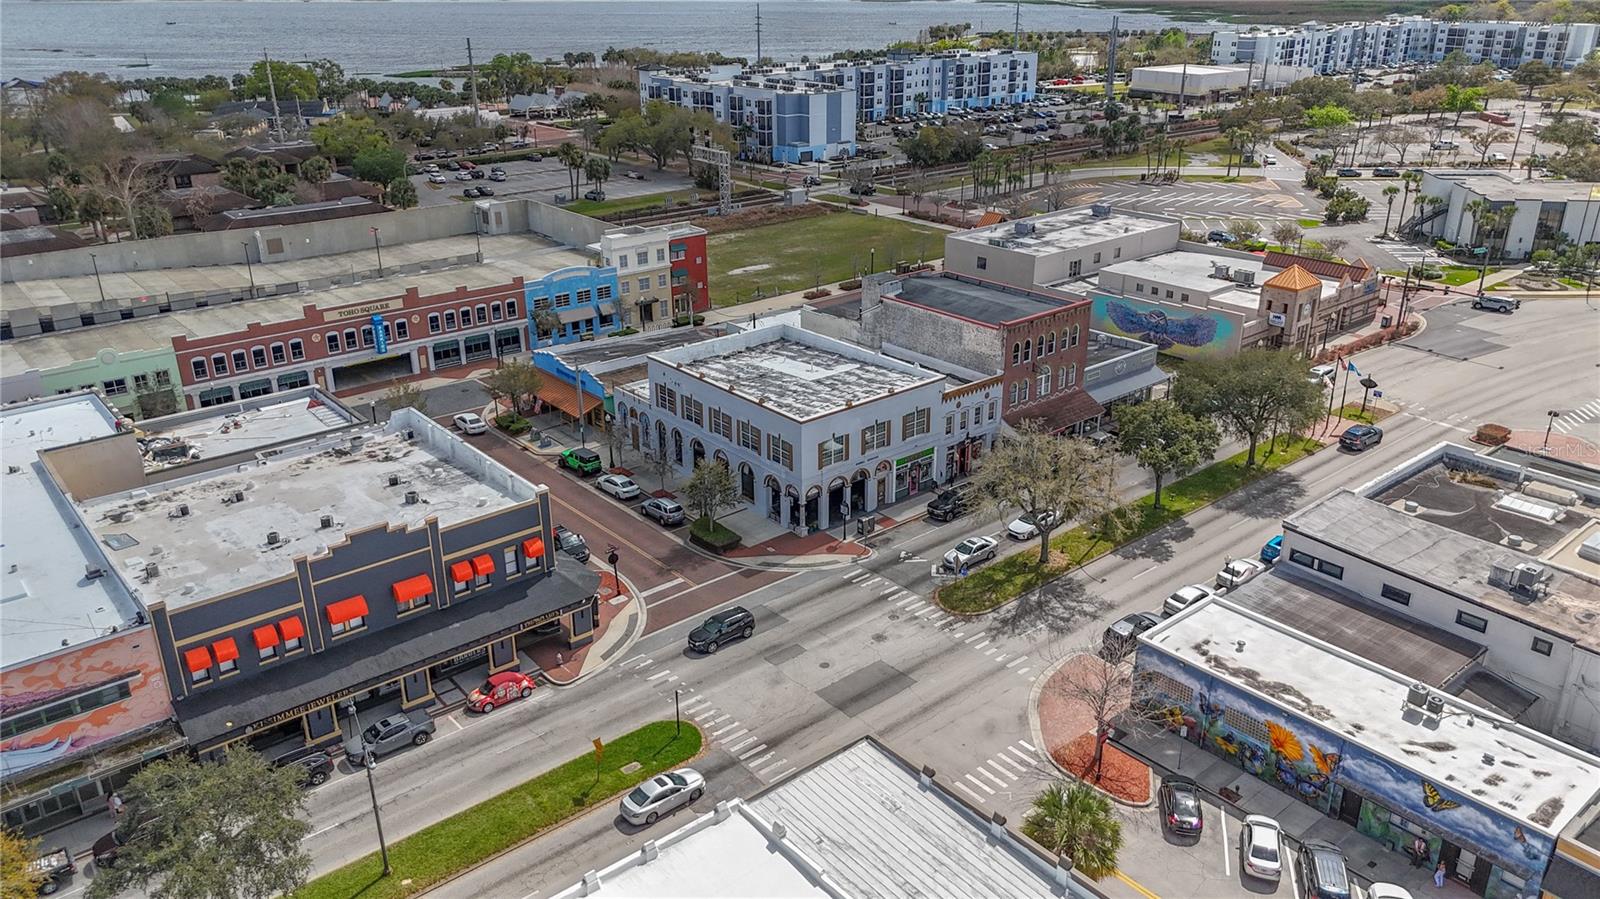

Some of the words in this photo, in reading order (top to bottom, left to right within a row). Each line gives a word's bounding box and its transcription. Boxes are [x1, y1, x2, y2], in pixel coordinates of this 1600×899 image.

[338, 308, 360, 317] TOHO
[360, 303, 390, 313] SQUARE
[378, 325, 387, 353] PARKING
[252, 705, 306, 730] KISSIMMEE
[307, 688, 354, 712] JEWELERS
